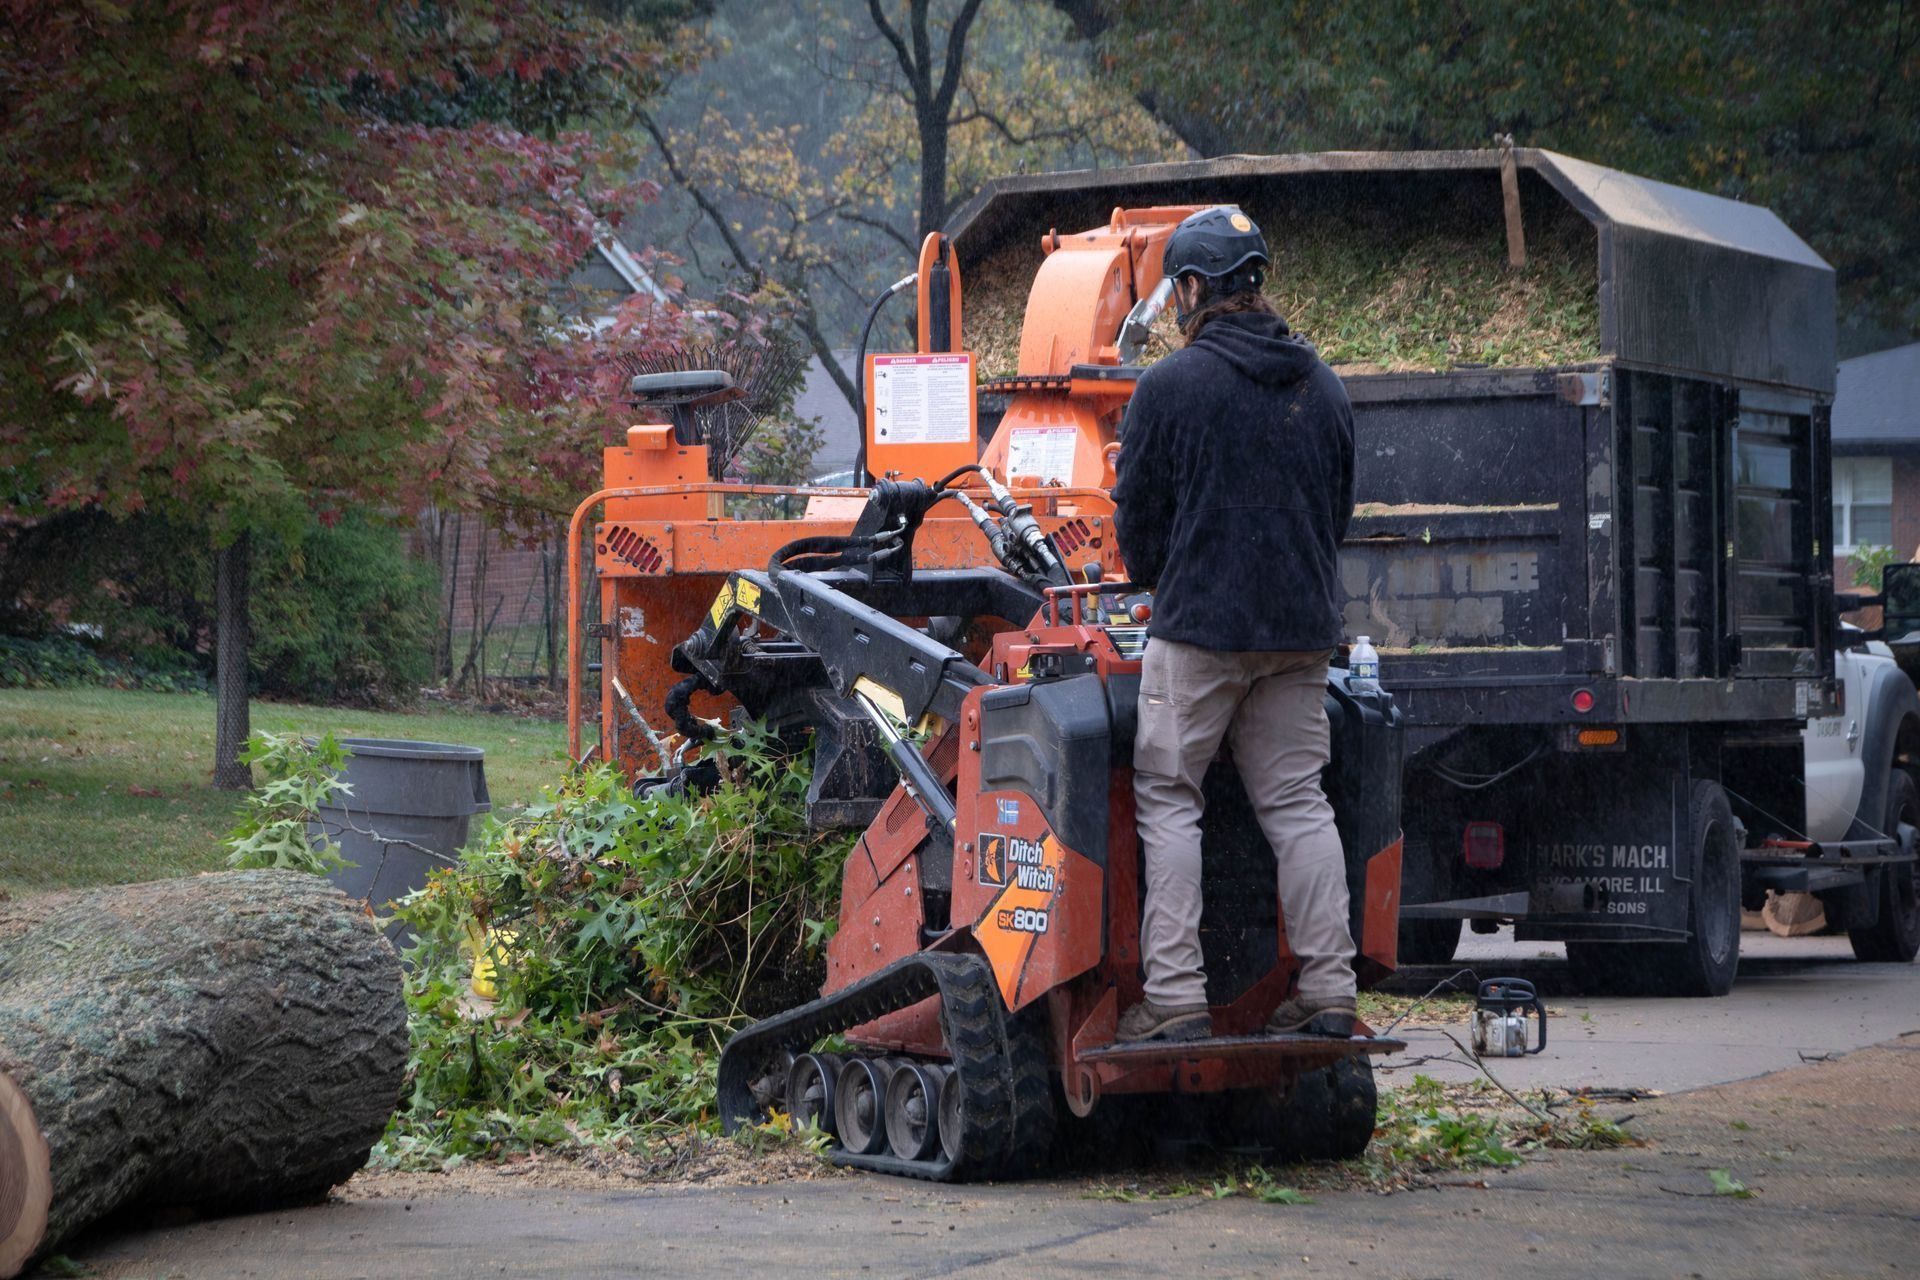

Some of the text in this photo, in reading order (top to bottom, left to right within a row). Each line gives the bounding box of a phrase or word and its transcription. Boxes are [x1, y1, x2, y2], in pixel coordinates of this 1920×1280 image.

[1008, 838, 1044, 864] Ditch
[1612, 844, 1670, 869] MACH.
[1016, 864, 1054, 891] Witch
[1607, 901, 1647, 914] SONS
[998, 909, 1048, 932] SK800
